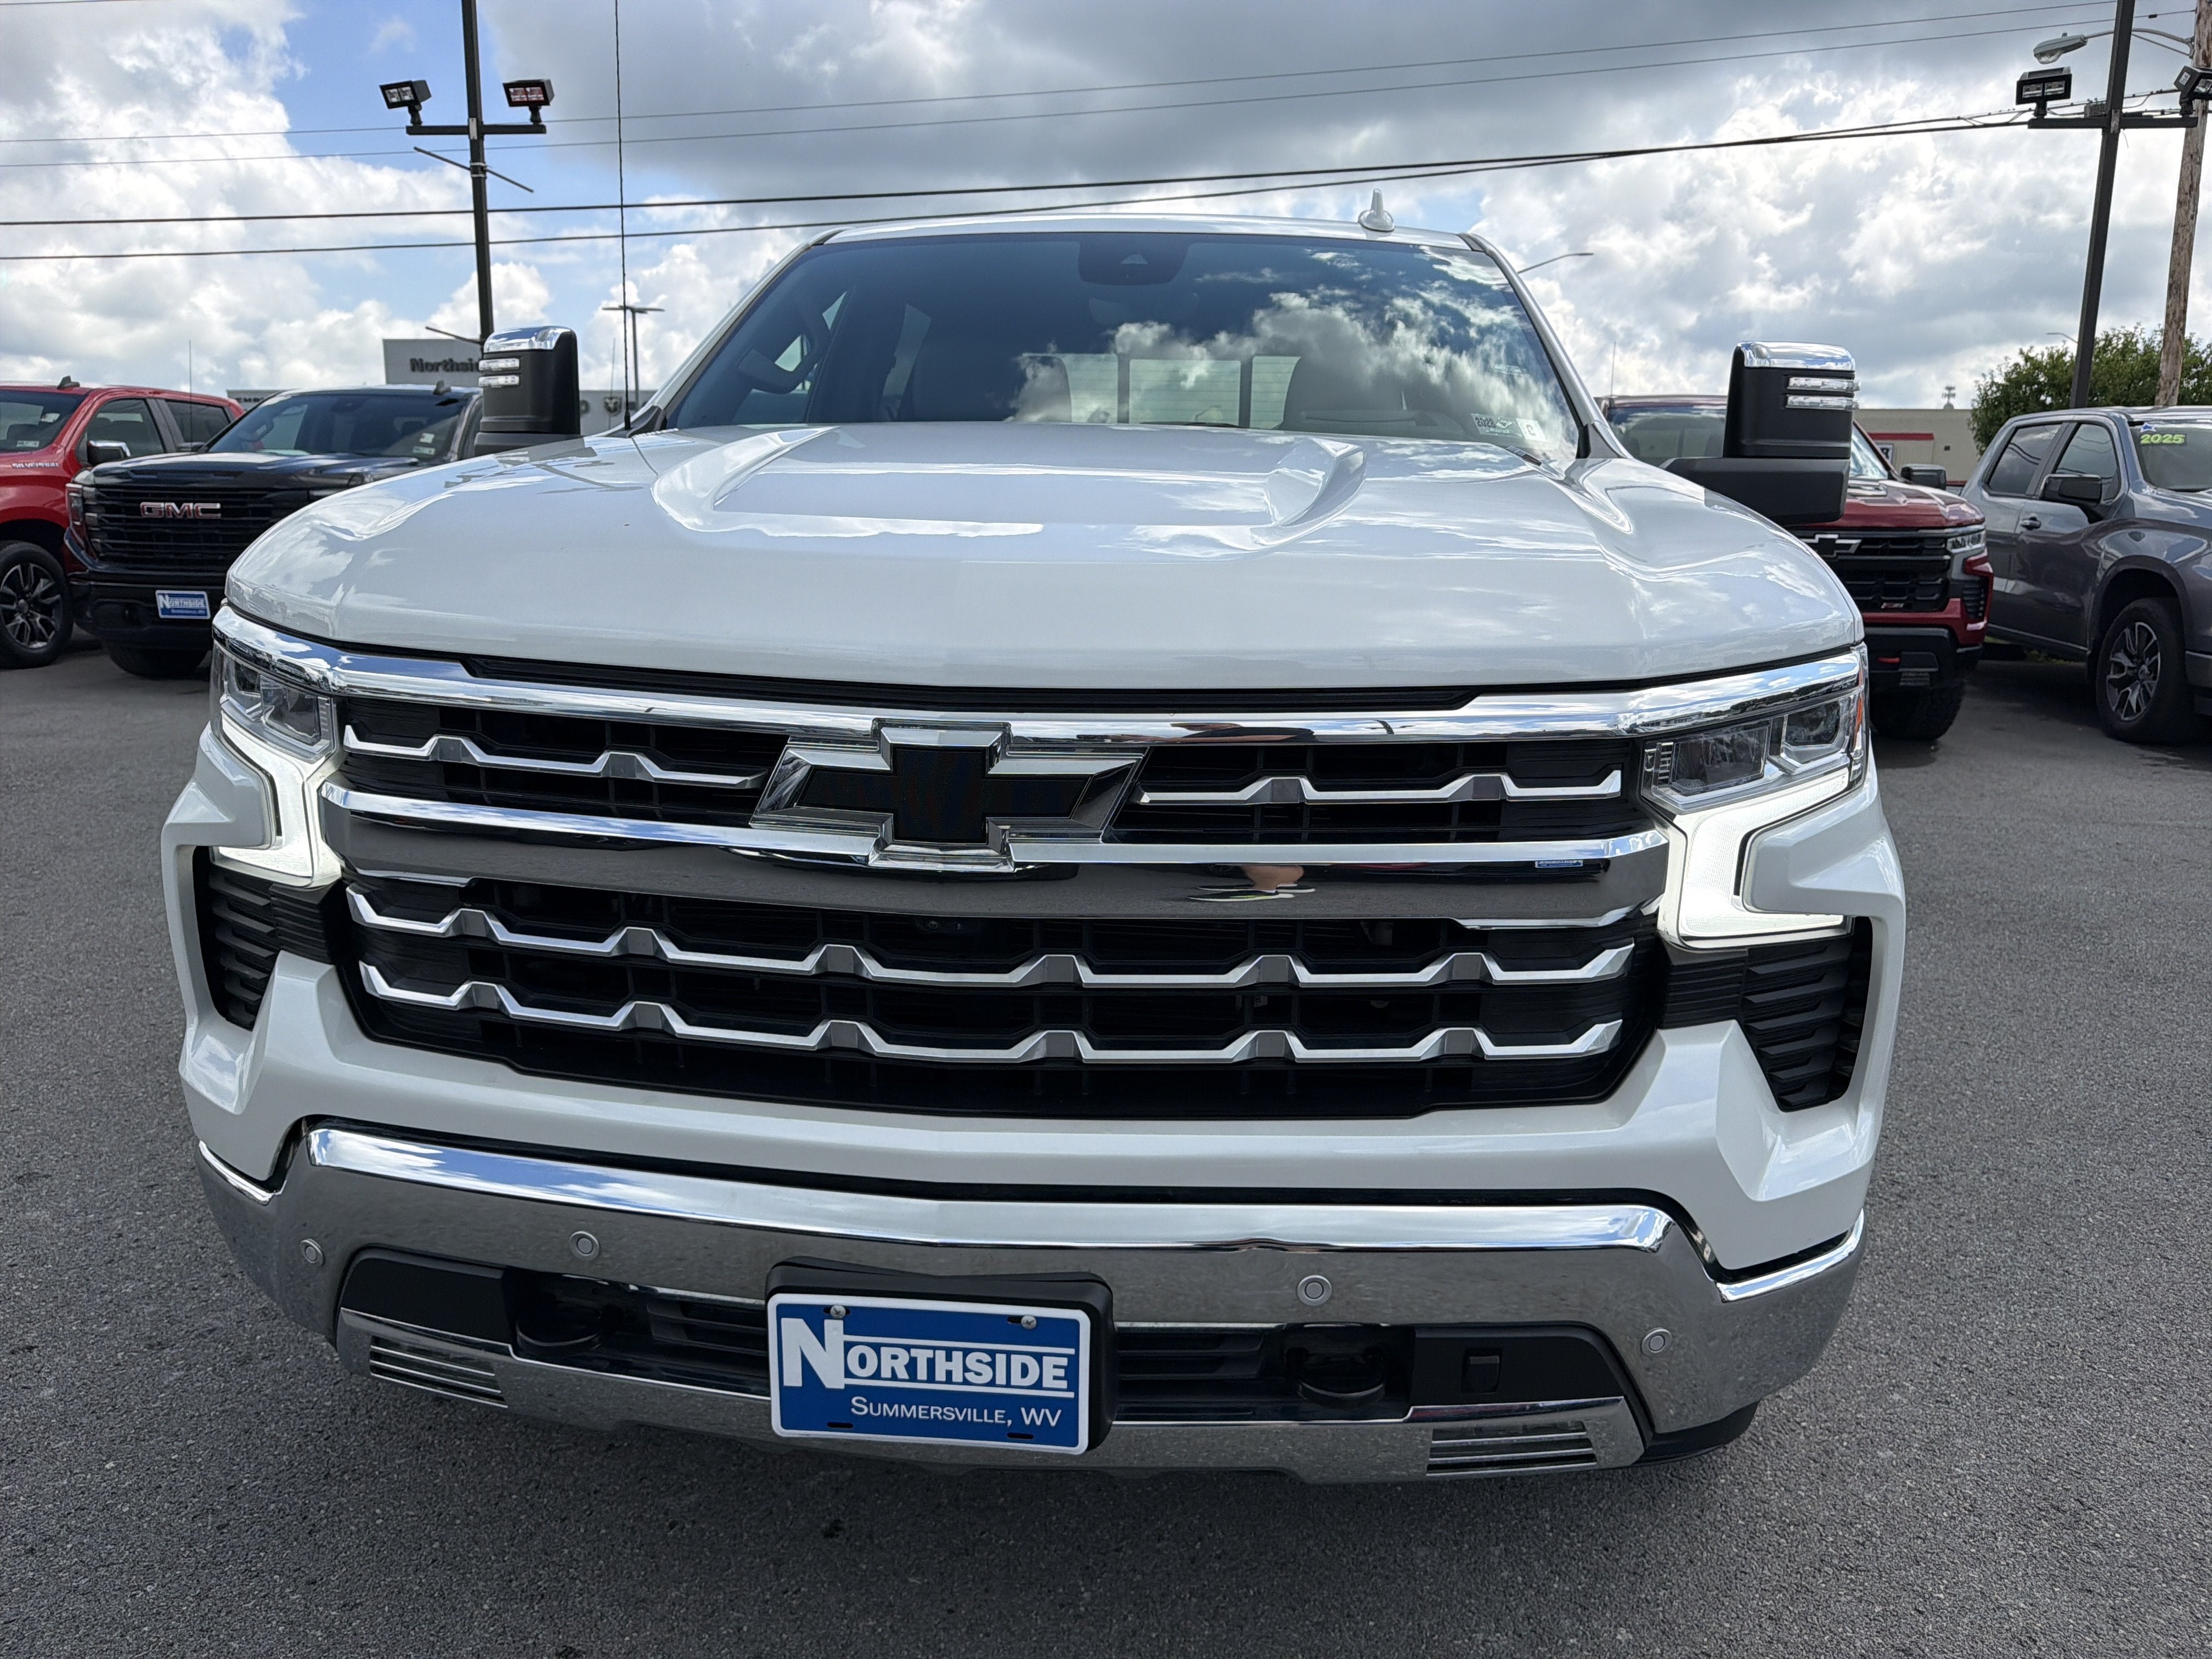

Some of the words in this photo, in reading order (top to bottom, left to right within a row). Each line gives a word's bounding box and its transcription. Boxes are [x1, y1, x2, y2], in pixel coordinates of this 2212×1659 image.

[2140, 433, 2186, 444] 2025
[140, 501, 221, 518] GMC
[781, 1317, 1068, 1389] NORTHSIDE
[851, 1396, 1012, 1427] SUMMERSVILLE,
[1021, 1407, 1062, 1427] WV
